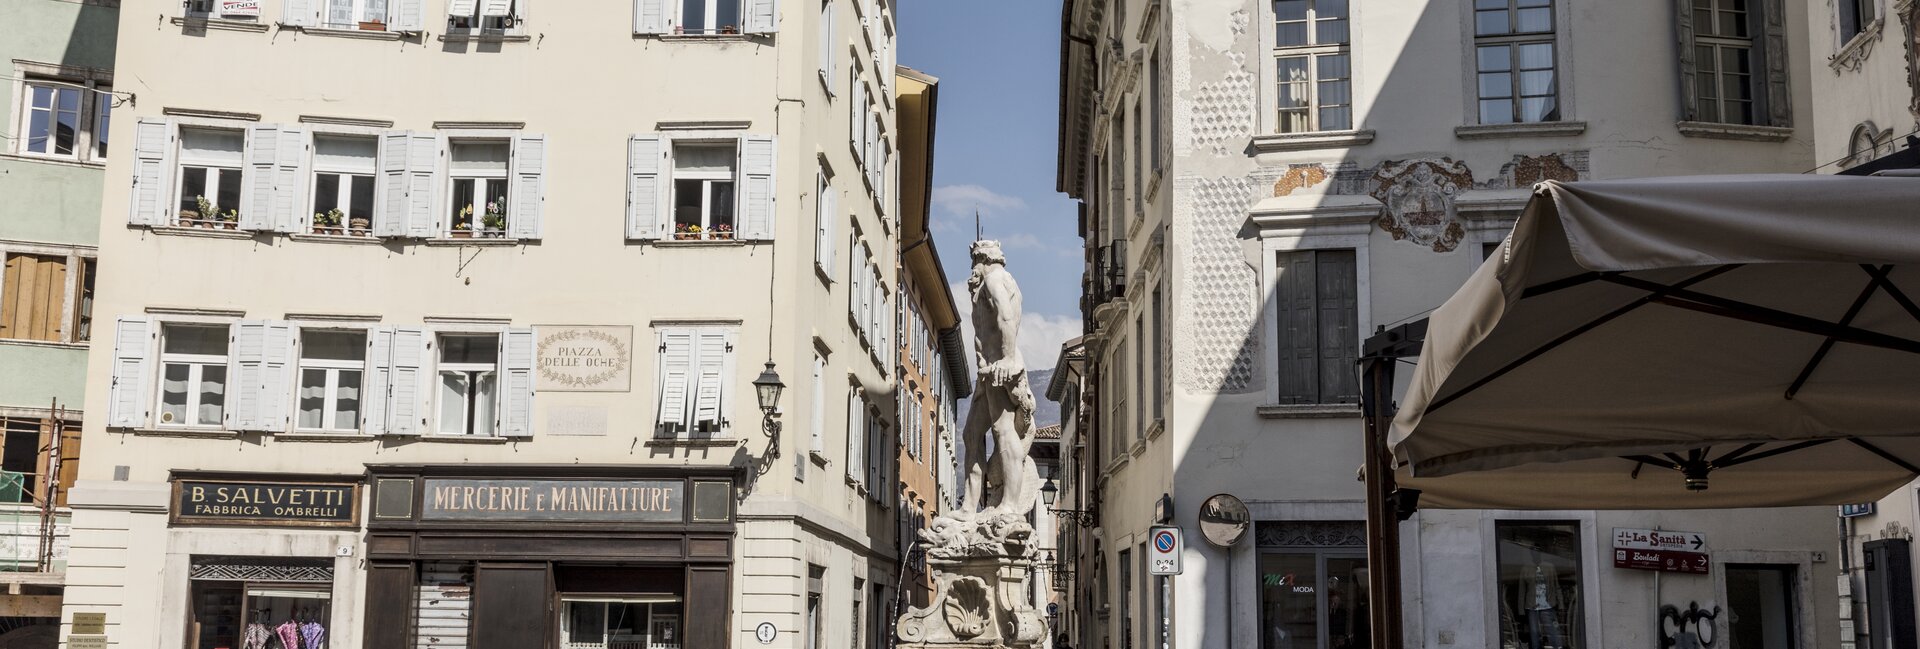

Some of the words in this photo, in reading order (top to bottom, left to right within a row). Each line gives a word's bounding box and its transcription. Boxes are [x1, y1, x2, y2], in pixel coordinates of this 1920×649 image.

[558, 347, 602, 357] PIAZZA
[545, 357, 580, 367] DELLE
[586, 358, 616, 368] OCHE
[191, 486, 208, 503] B.
[216, 487, 344, 505] SALVETTI
[433, 486, 531, 511] MERCERIE
[551, 487, 673, 512] MANIFATTURE
[195, 505, 261, 515] FABBRICA
[274, 506, 337, 517] OMBRELLI
[1633, 533, 1647, 542] La
[1650, 532, 1686, 547] Sanità
